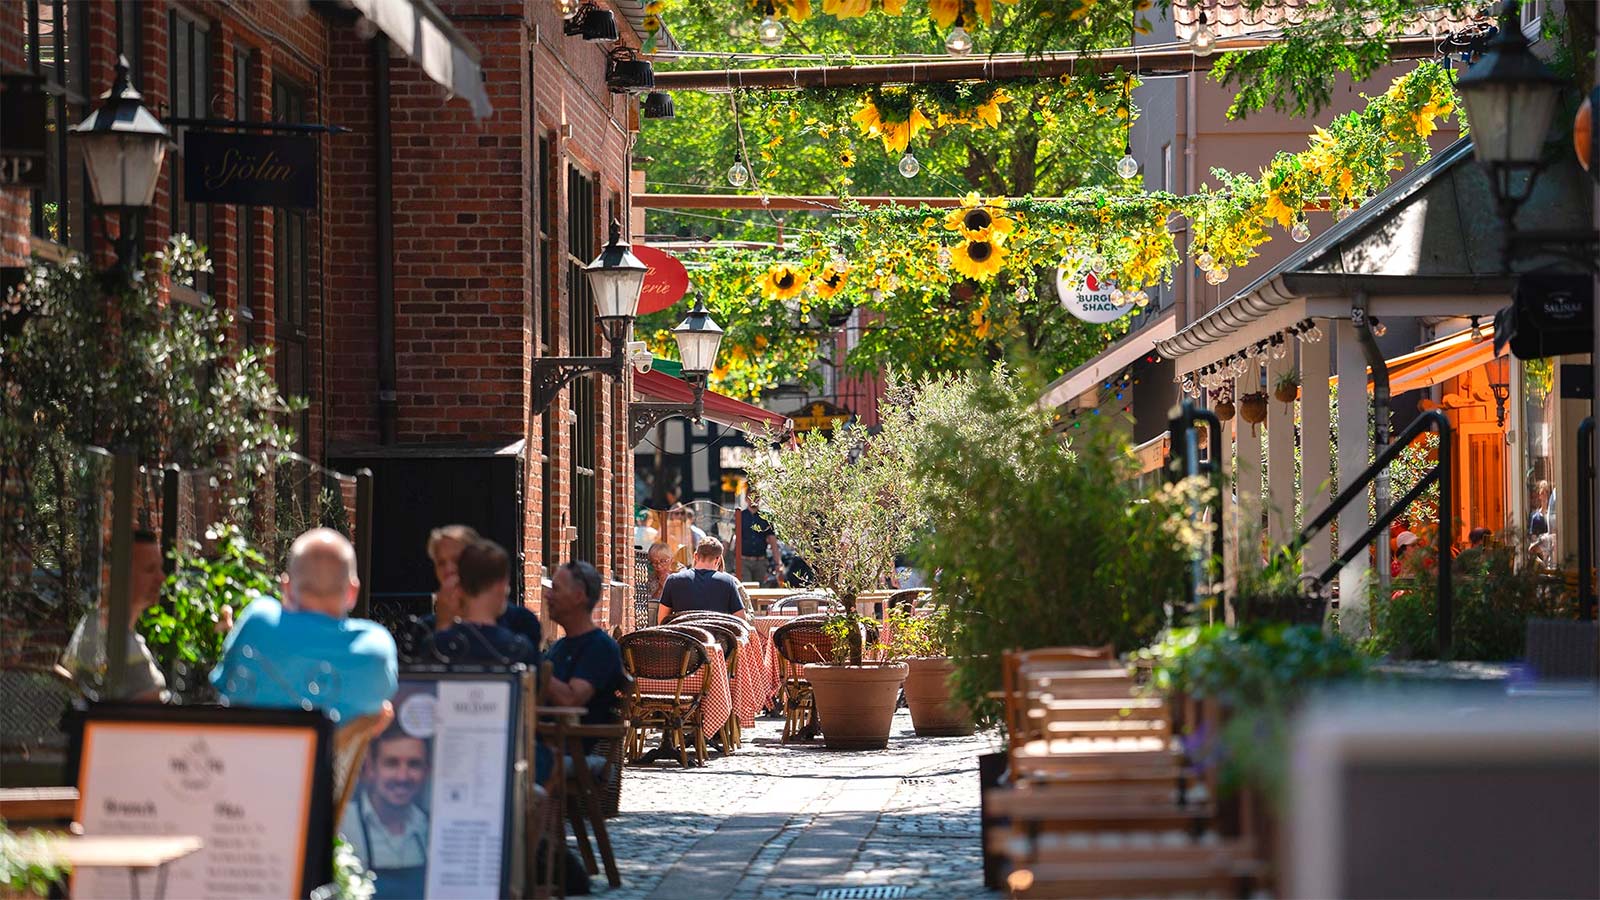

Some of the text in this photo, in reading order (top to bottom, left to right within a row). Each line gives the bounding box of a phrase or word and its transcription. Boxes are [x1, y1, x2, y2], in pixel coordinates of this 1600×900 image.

[203, 148, 294, 191] Sjölin
[1078, 294, 1113, 303] BURG
[1082, 303, 1118, 312] SHACK
